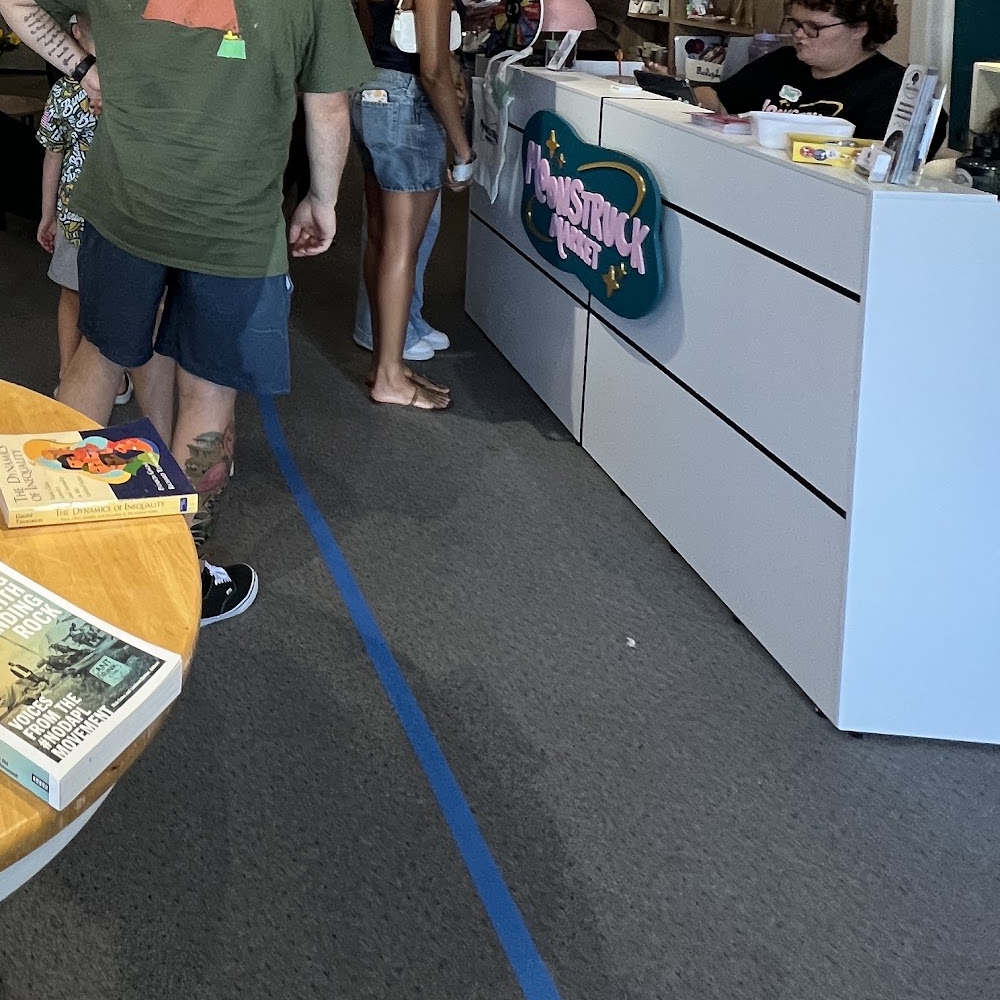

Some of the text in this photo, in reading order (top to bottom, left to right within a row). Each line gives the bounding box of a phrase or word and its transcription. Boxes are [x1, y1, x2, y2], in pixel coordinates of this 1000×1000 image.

[72, 505, 111, 515] DYNAMICS
[124, 501, 165, 511] INEQUALITY
[11, 603, 63, 640] ROCK
[8, 696, 54, 732] VOICES
[22, 692, 83, 742] FROM THE
[37, 705, 92, 751] #NODAPL
[51, 704, 114, 760] MOVEMENT
